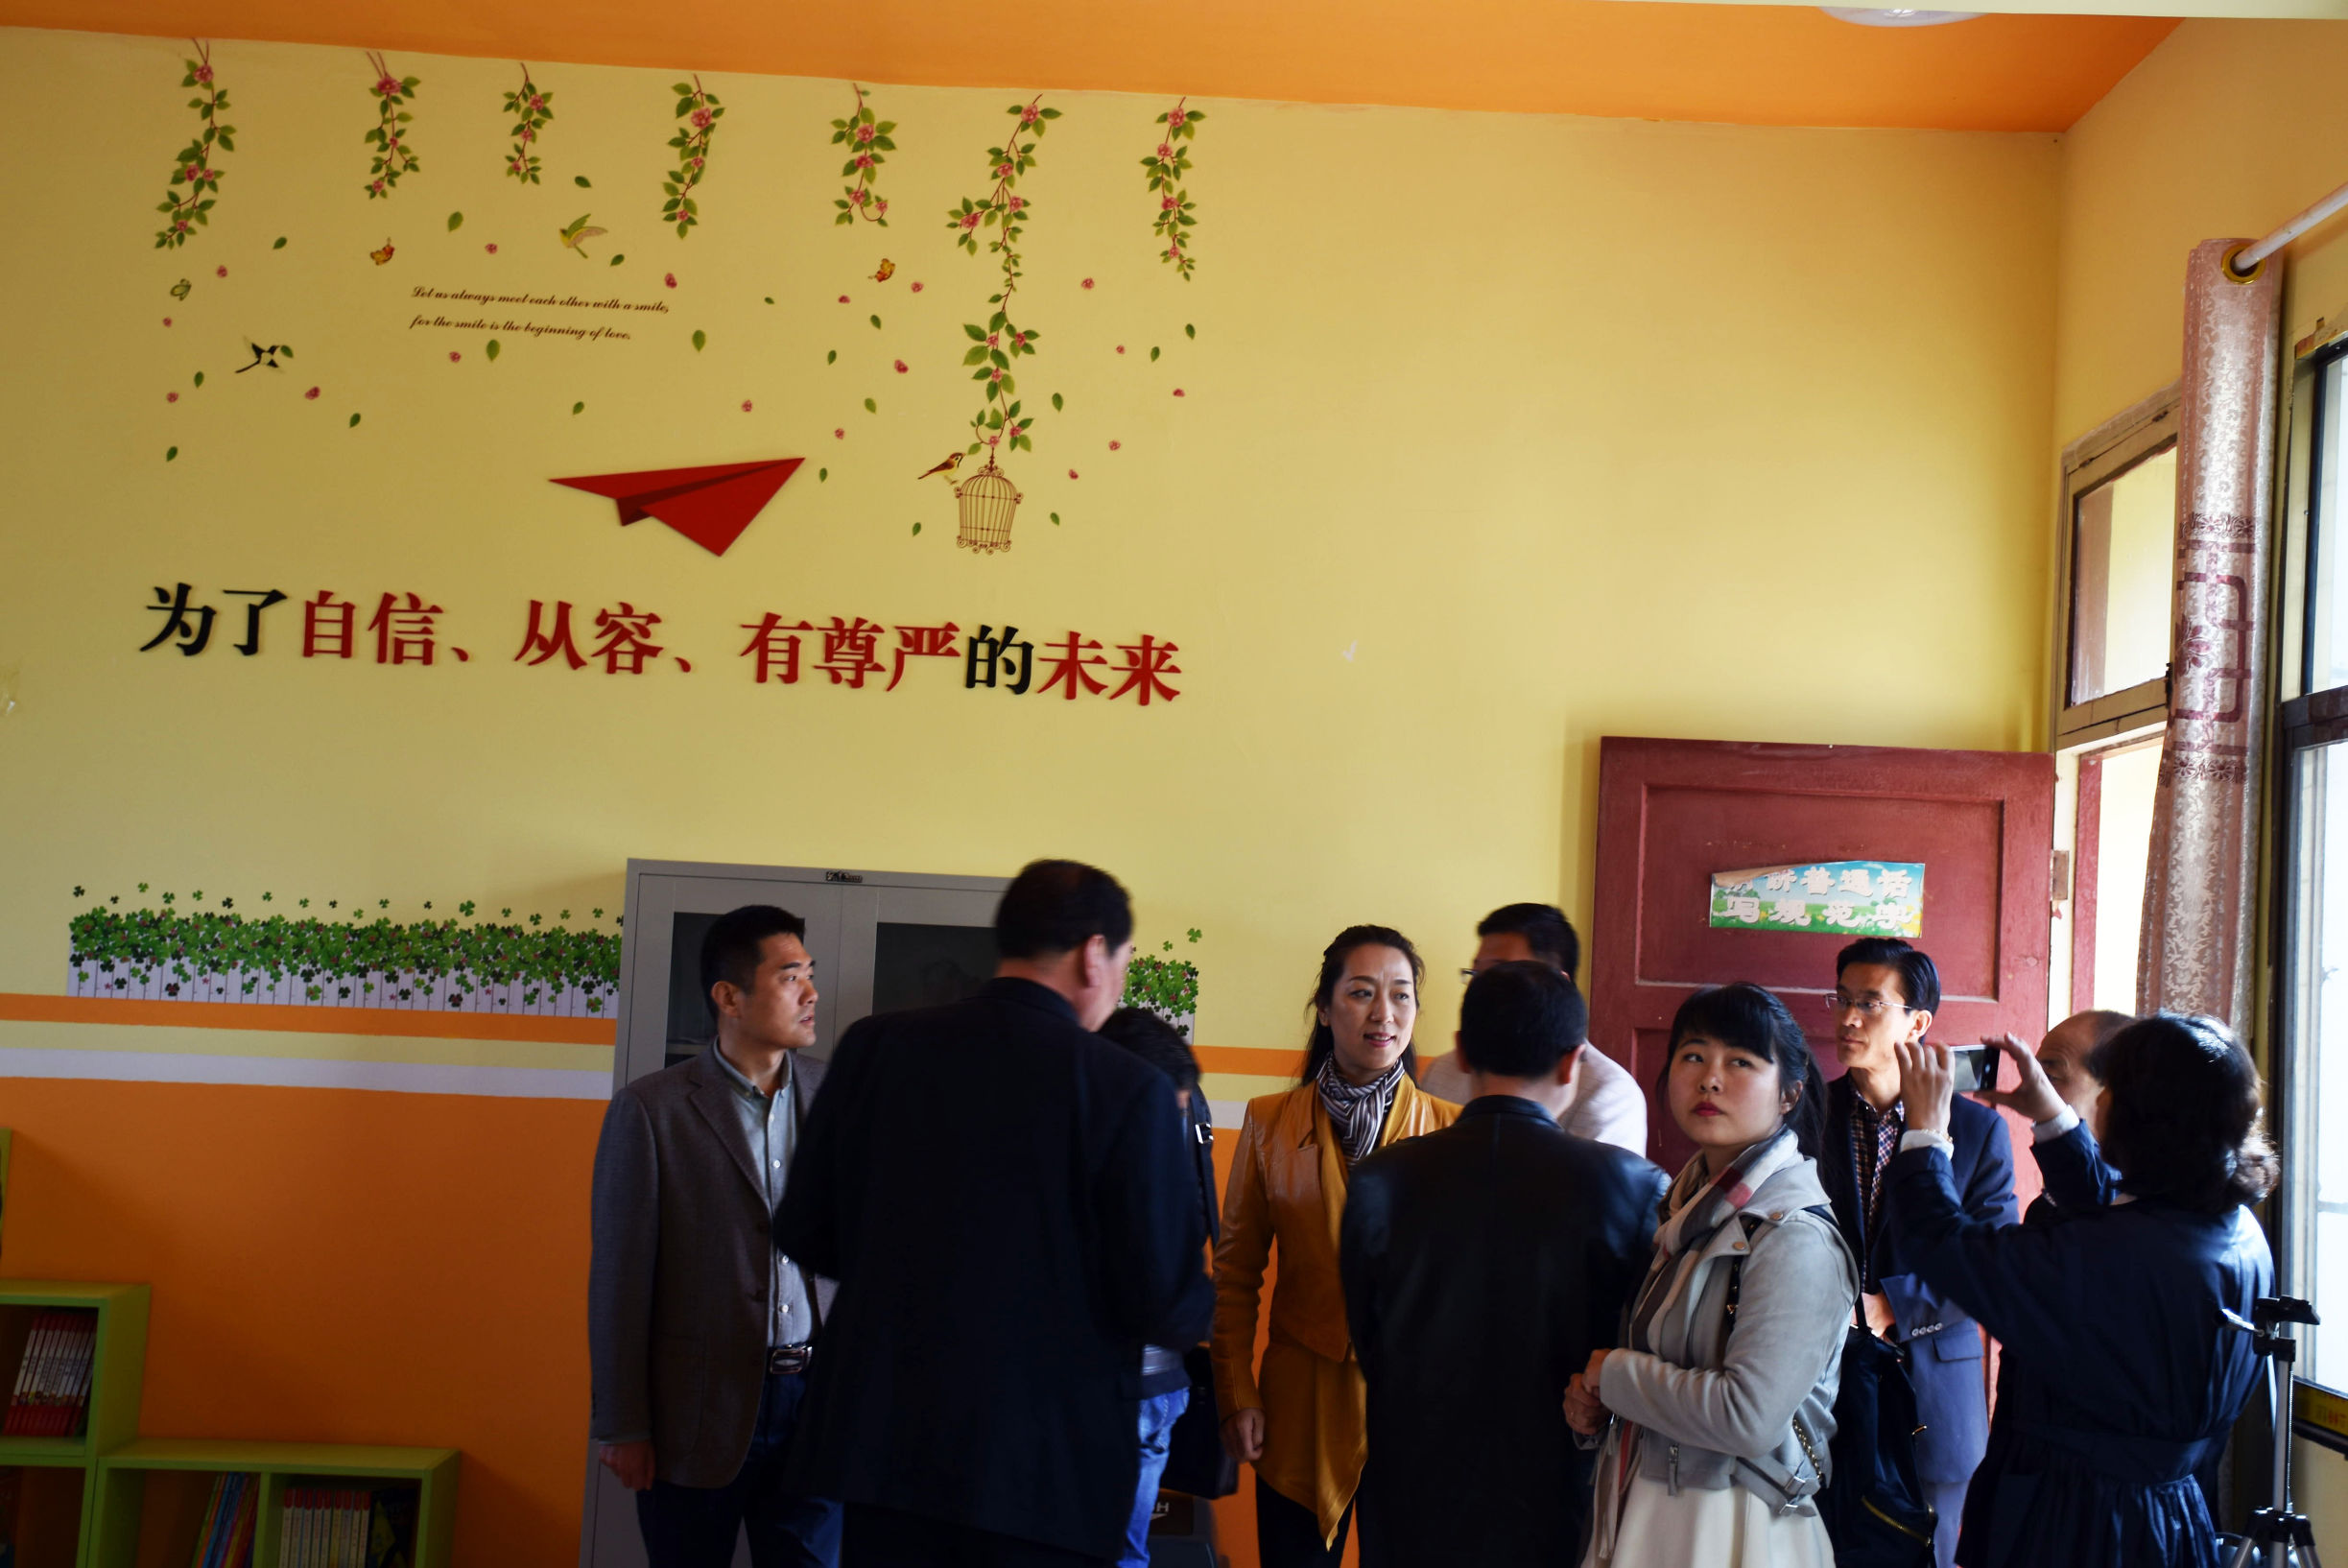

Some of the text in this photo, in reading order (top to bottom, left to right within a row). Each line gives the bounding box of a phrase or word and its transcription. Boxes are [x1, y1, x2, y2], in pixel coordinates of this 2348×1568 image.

[412, 286, 669, 314] Let us always meet each other with a smile,
[409, 314, 431, 329] for
[433, 317, 452, 327] the
[455, 319, 486, 329] smile
[489, 321, 500, 331] is
[502, 321, 521, 332] the
[523, 322, 586, 340] beginning
[588, 326, 605, 342] of
[139, 582, 1182, 706] 为了自信、从容、有尊严的未来
[1718, 896, 1911, 930] 写规范字
